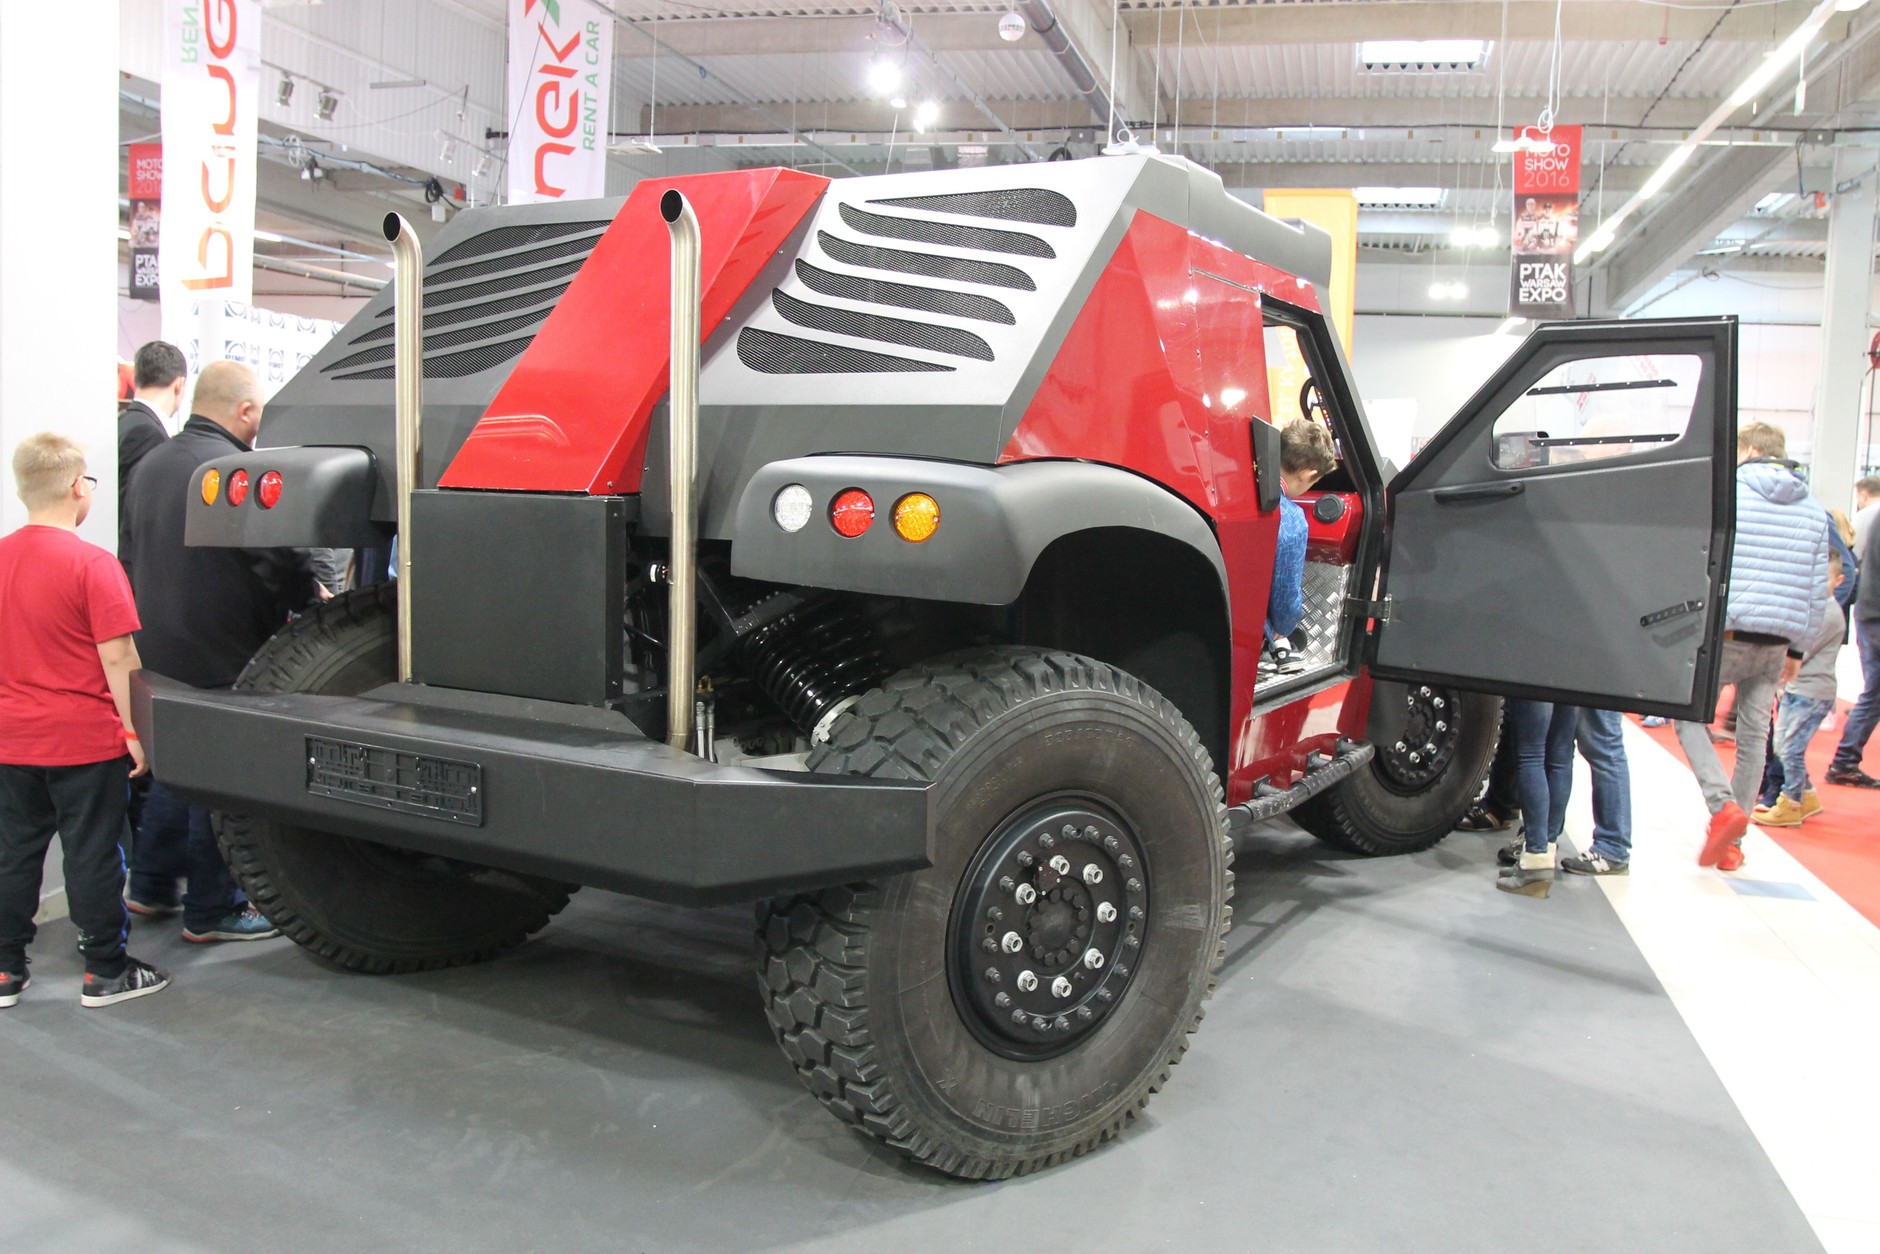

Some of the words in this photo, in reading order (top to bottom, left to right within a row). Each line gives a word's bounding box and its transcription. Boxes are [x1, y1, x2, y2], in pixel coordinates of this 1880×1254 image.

[585, 20, 600, 66] CAR
[585, 71, 598, 88] A
[582, 92, 598, 151] RENT
[1525, 157, 1569, 171] SHOW
[136, 180, 161, 193] 201
[1524, 171, 1570, 187] 2016
[136, 254, 159, 268] PTA
[1520, 263, 1566, 280] PTAK
[135, 274, 159, 286] EXP
[1520, 279, 1566, 289] WARSAW
[1519, 288, 1567, 302] EXPO
[973, 1081, 1118, 1129] MICHELIN
